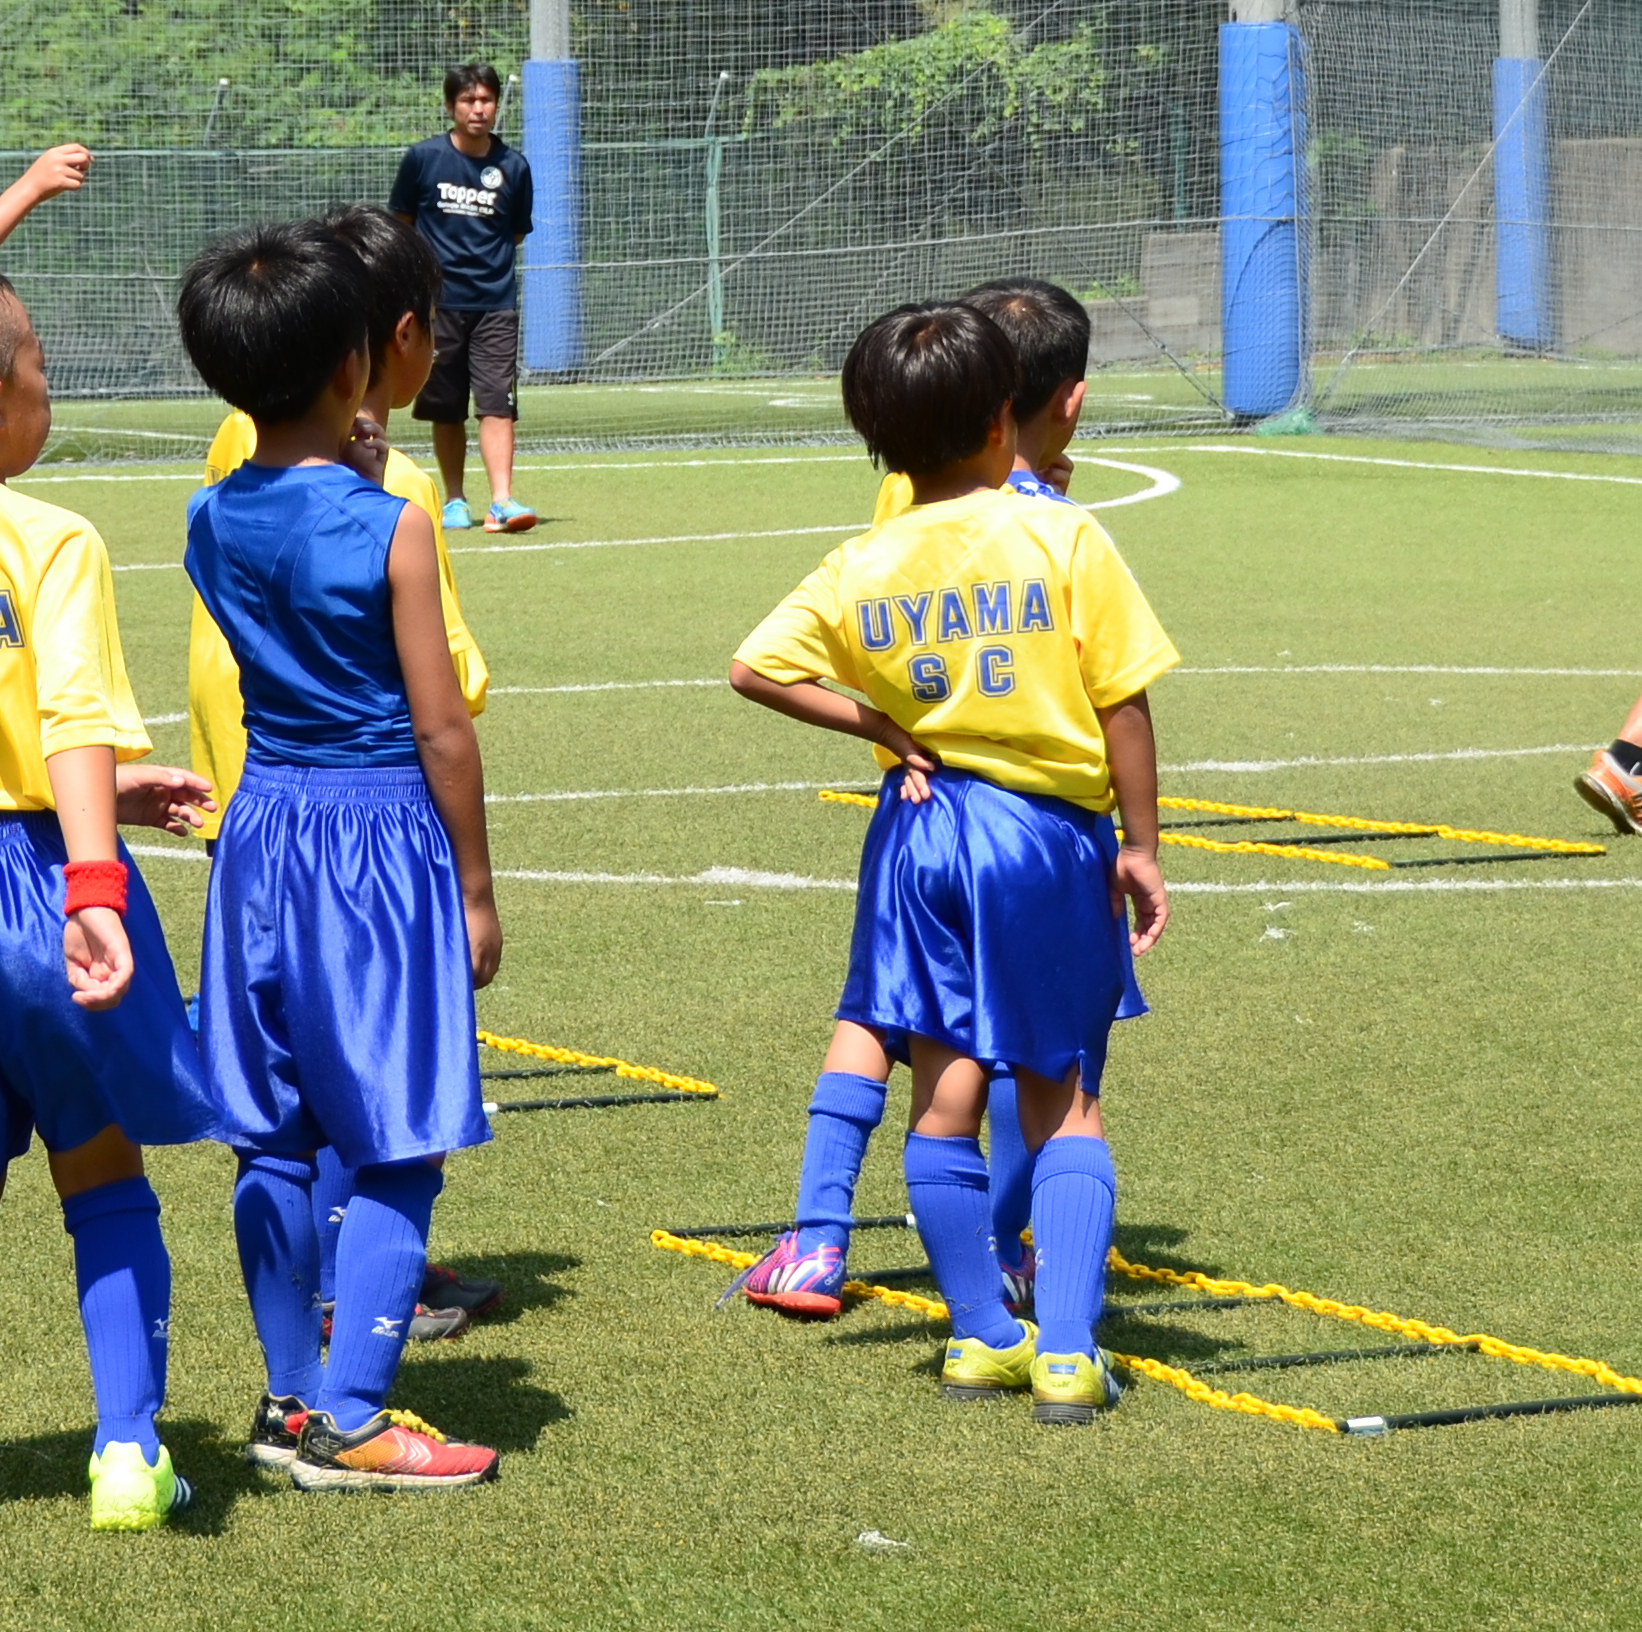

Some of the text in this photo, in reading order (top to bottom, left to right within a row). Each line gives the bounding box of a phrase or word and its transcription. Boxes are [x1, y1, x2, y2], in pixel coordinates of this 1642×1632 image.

[437, 183, 497, 206] Topper
[856, 578, 1055, 651] UYAMA
[907, 644, 1016, 703] S C
